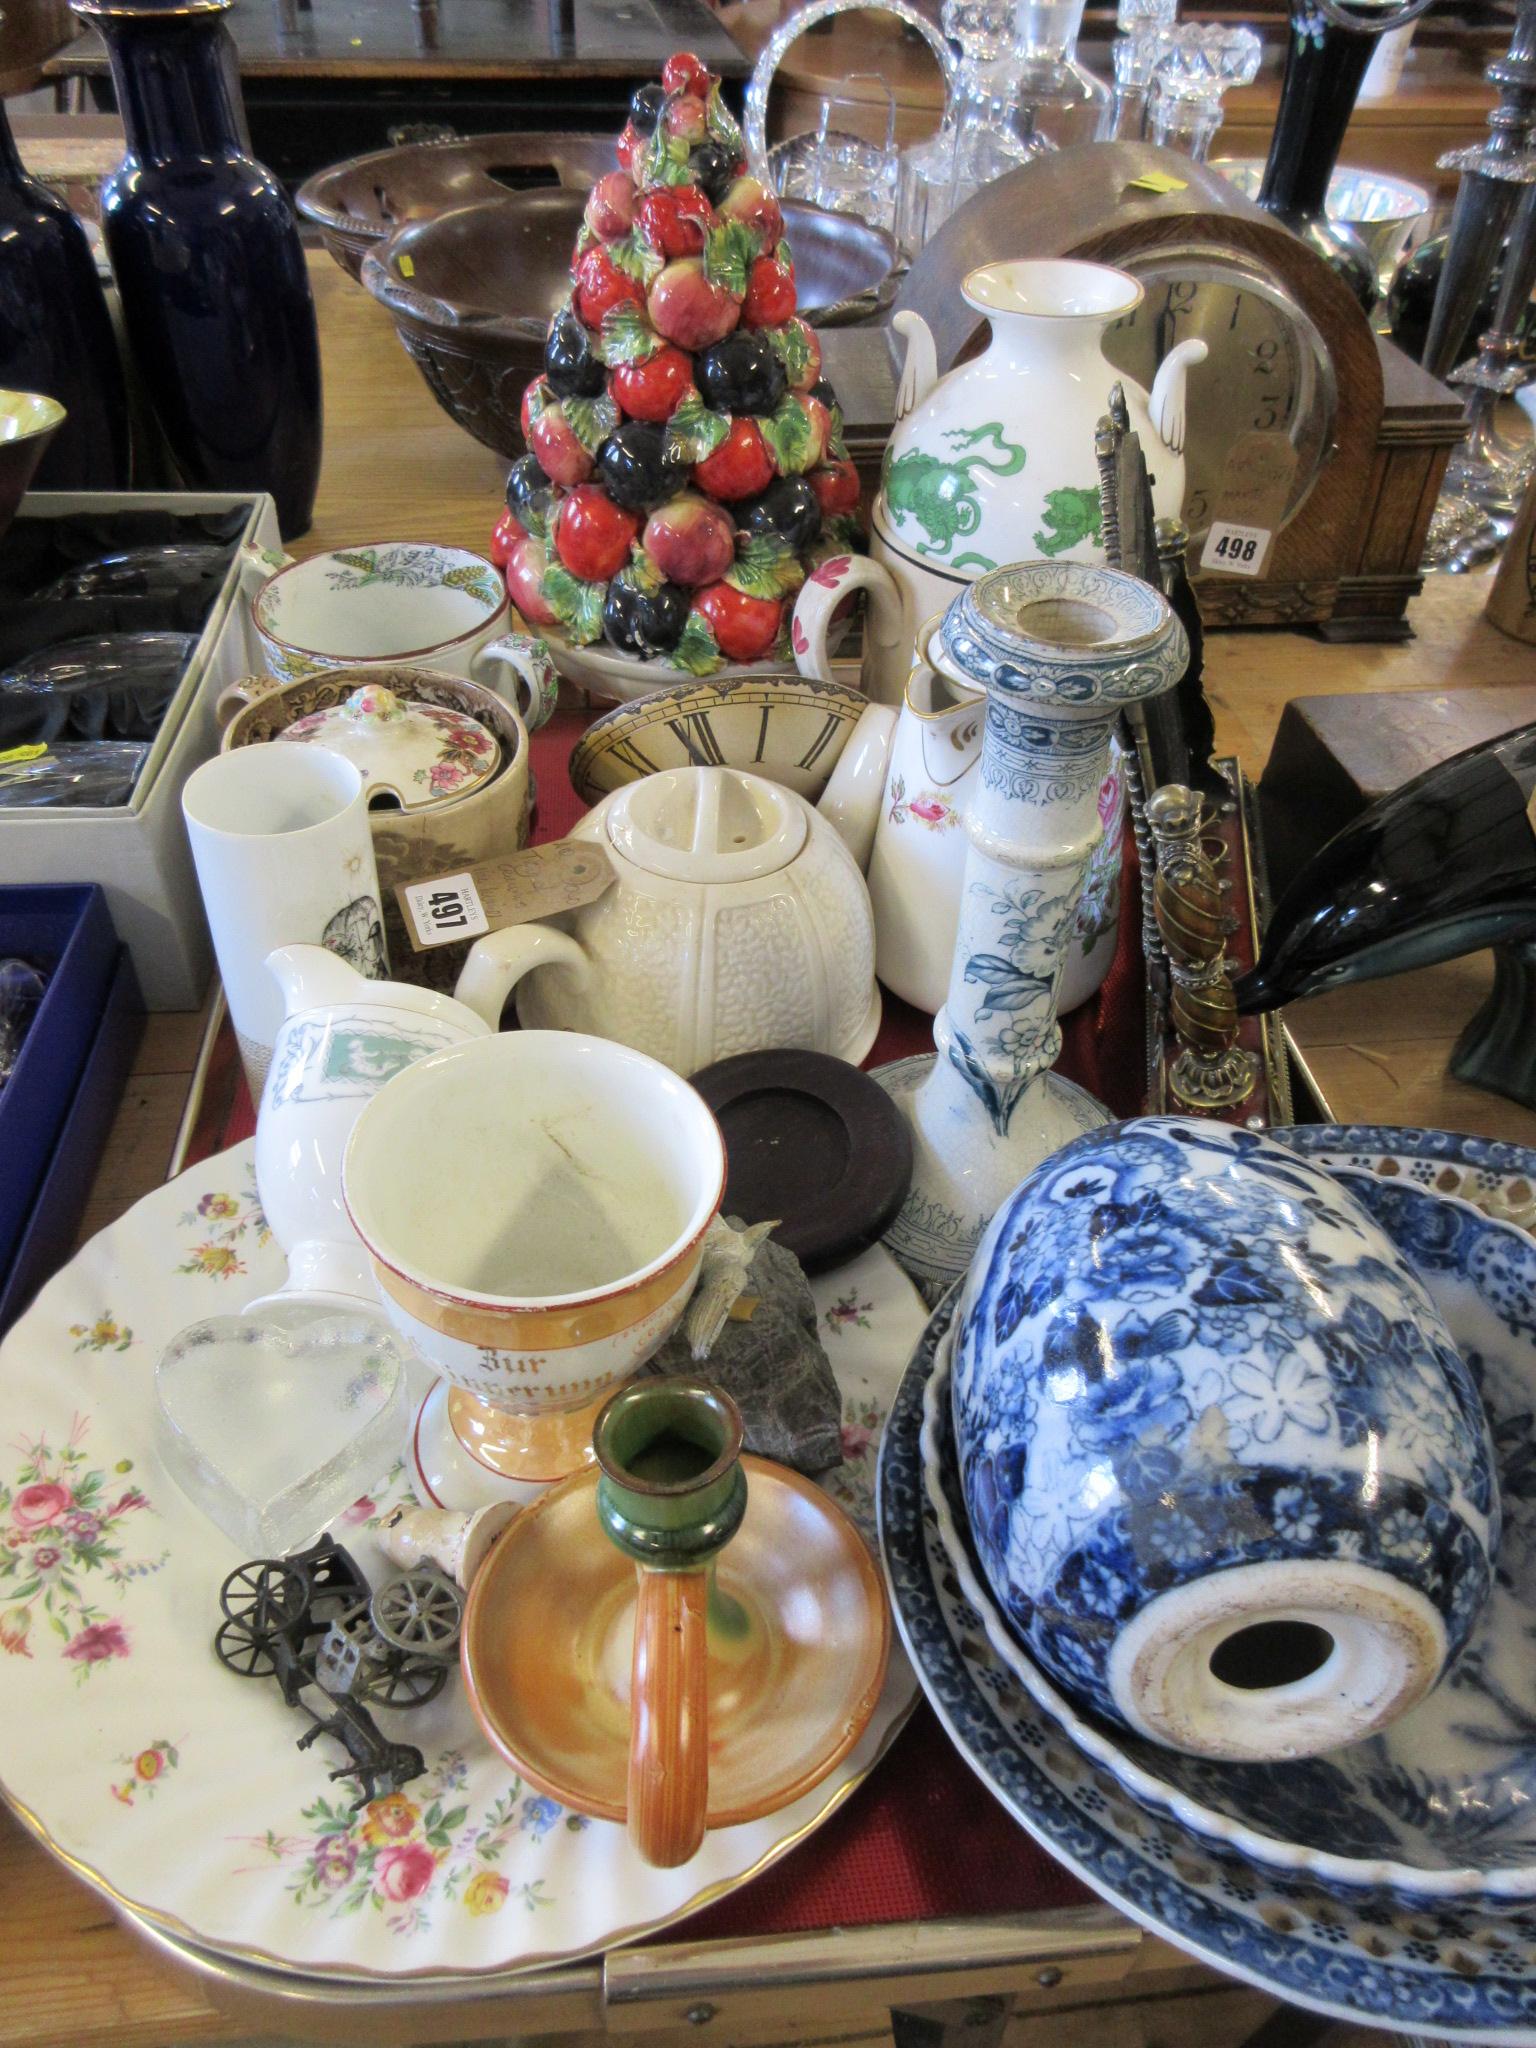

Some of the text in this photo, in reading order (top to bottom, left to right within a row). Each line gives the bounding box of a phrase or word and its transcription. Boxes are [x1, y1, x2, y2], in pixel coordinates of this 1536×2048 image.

[1229, 293, 1242, 330] 1
[1254, 340, 1279, 375] 2
[1254, 396, 1279, 430] 3
[1187, 489, 1210, 520] 5
[1214, 536, 1258, 562] 498
[428, 892, 468, 929] 497
[460, 888, 479, 921] HARTLEYS
